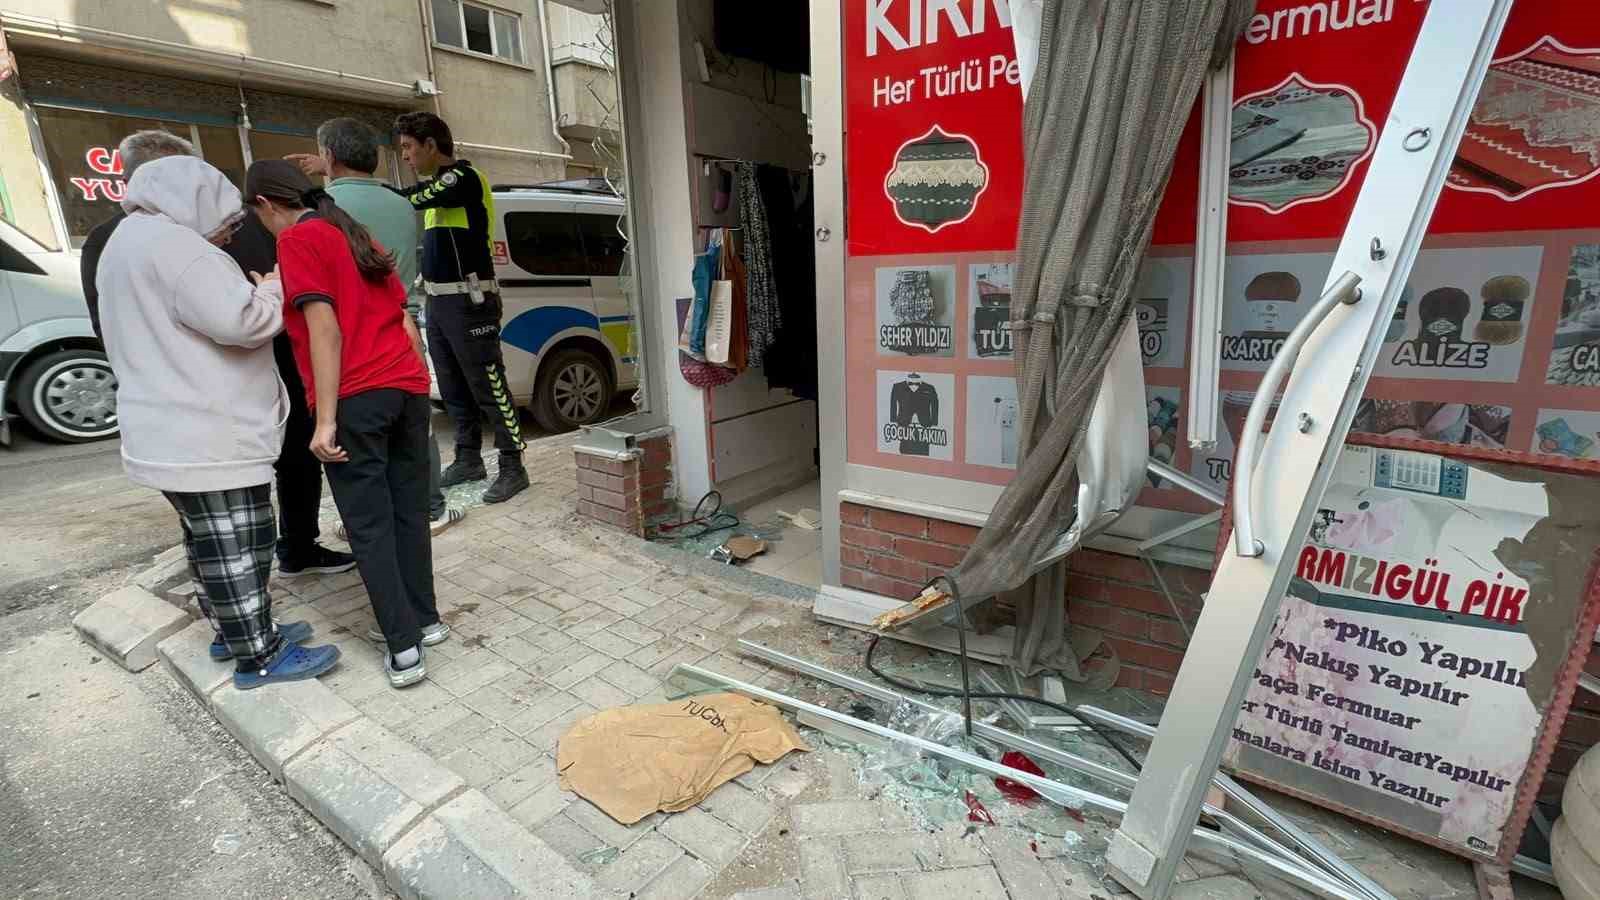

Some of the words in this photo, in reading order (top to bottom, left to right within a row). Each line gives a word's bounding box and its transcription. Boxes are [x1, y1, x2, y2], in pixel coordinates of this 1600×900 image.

[1244, 0, 1394, 44] ermuar
[873, 76, 915, 107] Her
[920, 59, 982, 98] Türlü
[989, 55, 1021, 88] Pe
[70, 177, 128, 201] YU
[881, 325, 912, 347] SEHER
[914, 326, 950, 348] YILDIZI
[1394, 336, 1489, 369] ALİZE
[884, 424, 916, 442] ÇOCUK
[918, 428, 947, 446] TAKIM
[1296, 545, 1451, 612] RMIZIGÜL
[1461, 571, 1528, 625] PİK
[1254, 669, 1299, 696] aça
[1305, 684, 1421, 730] Fermuar
[1368, 664, 1469, 707] Yapılır
[1264, 702, 1322, 736] Türlü
[1232, 727, 1306, 763] malara
[1369, 772, 1450, 808] Yazılır
